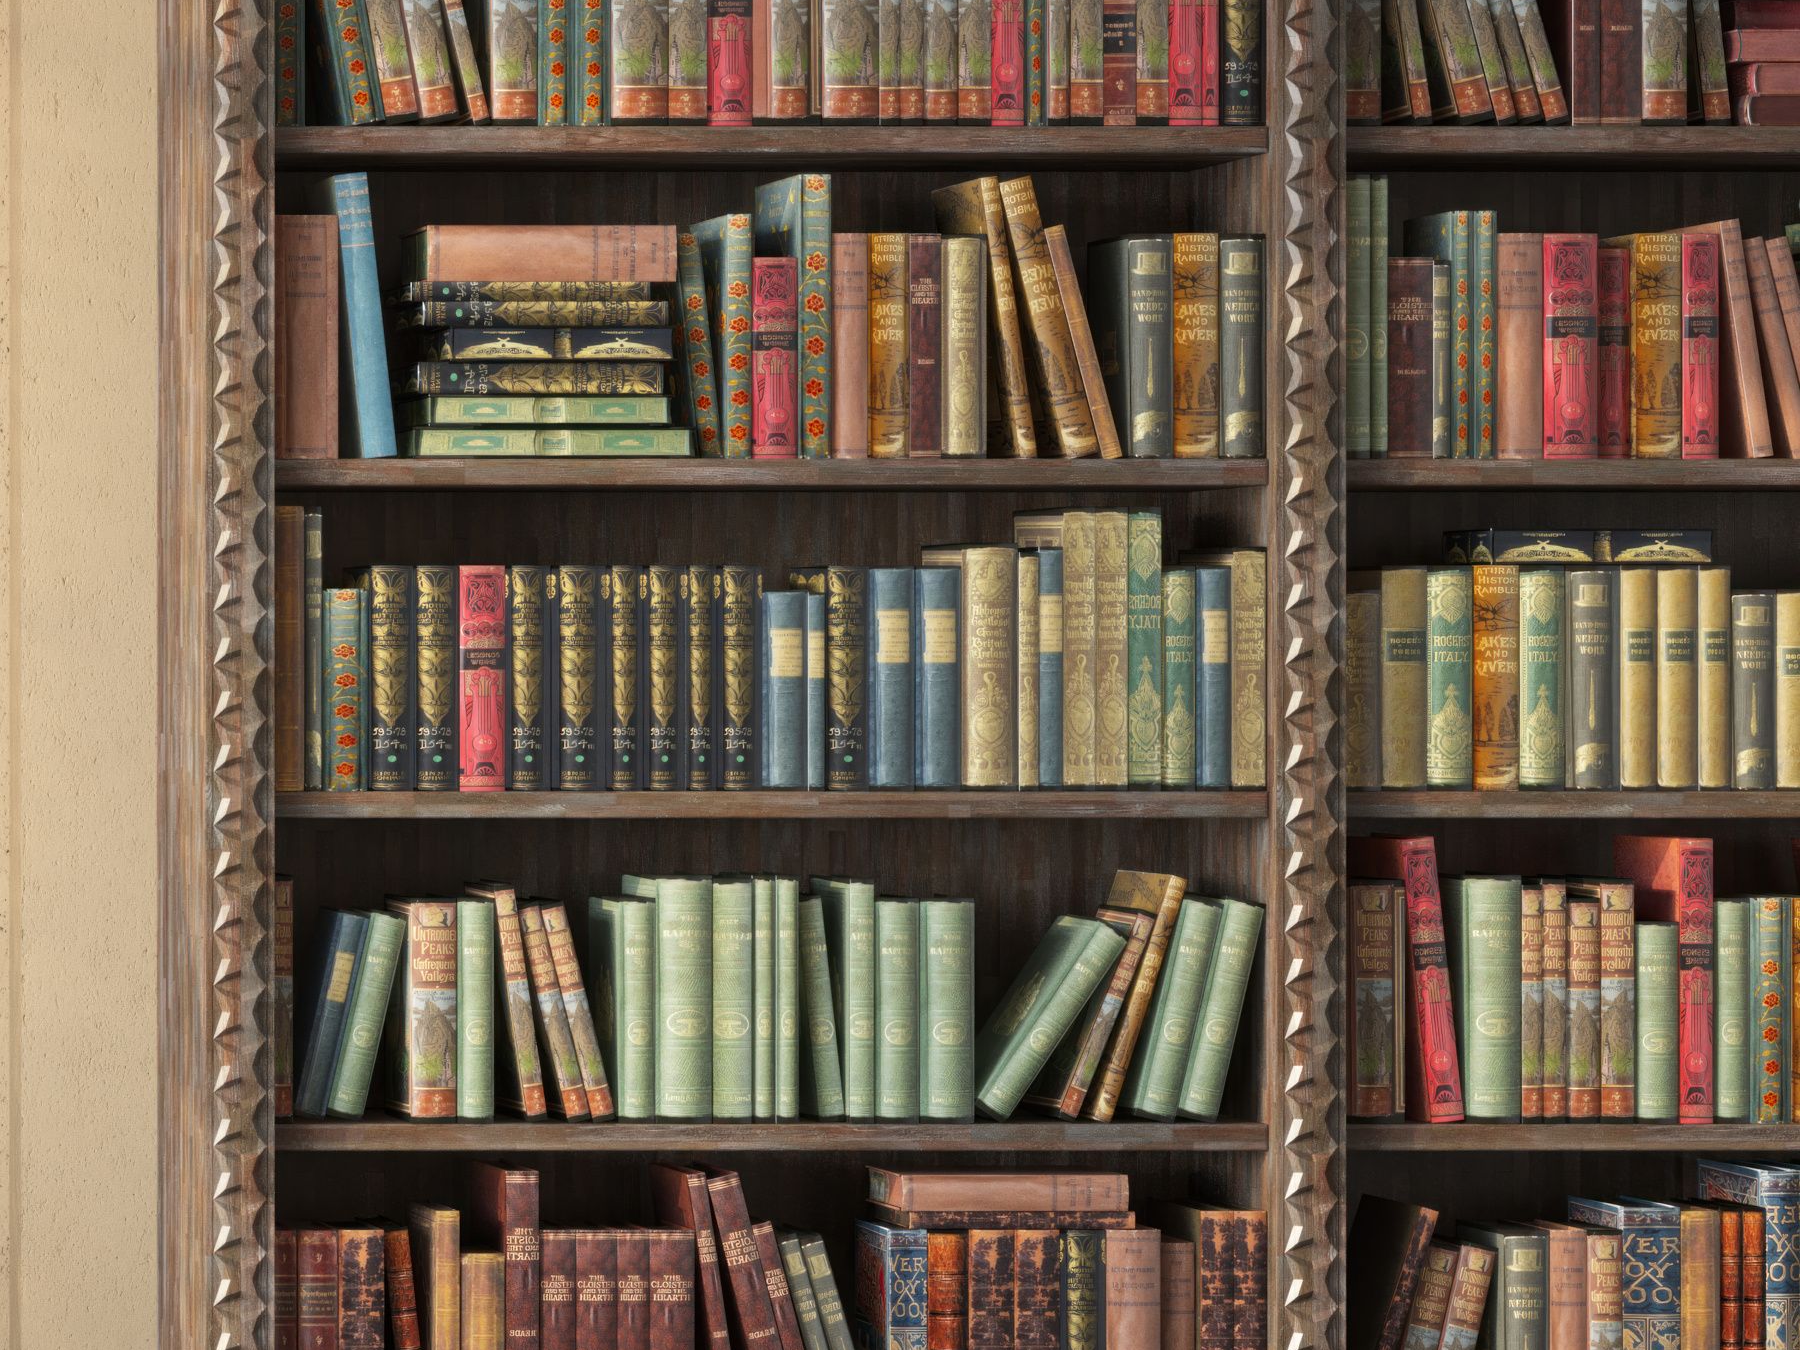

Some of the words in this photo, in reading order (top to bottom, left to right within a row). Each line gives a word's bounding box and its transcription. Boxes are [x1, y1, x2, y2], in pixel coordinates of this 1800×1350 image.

[1184, 316, 1208, 326] AND
[1647, 317, 1671, 326] AND
[1485, 650, 1508, 658] AND
[421, 941, 455, 955] PEAKS
